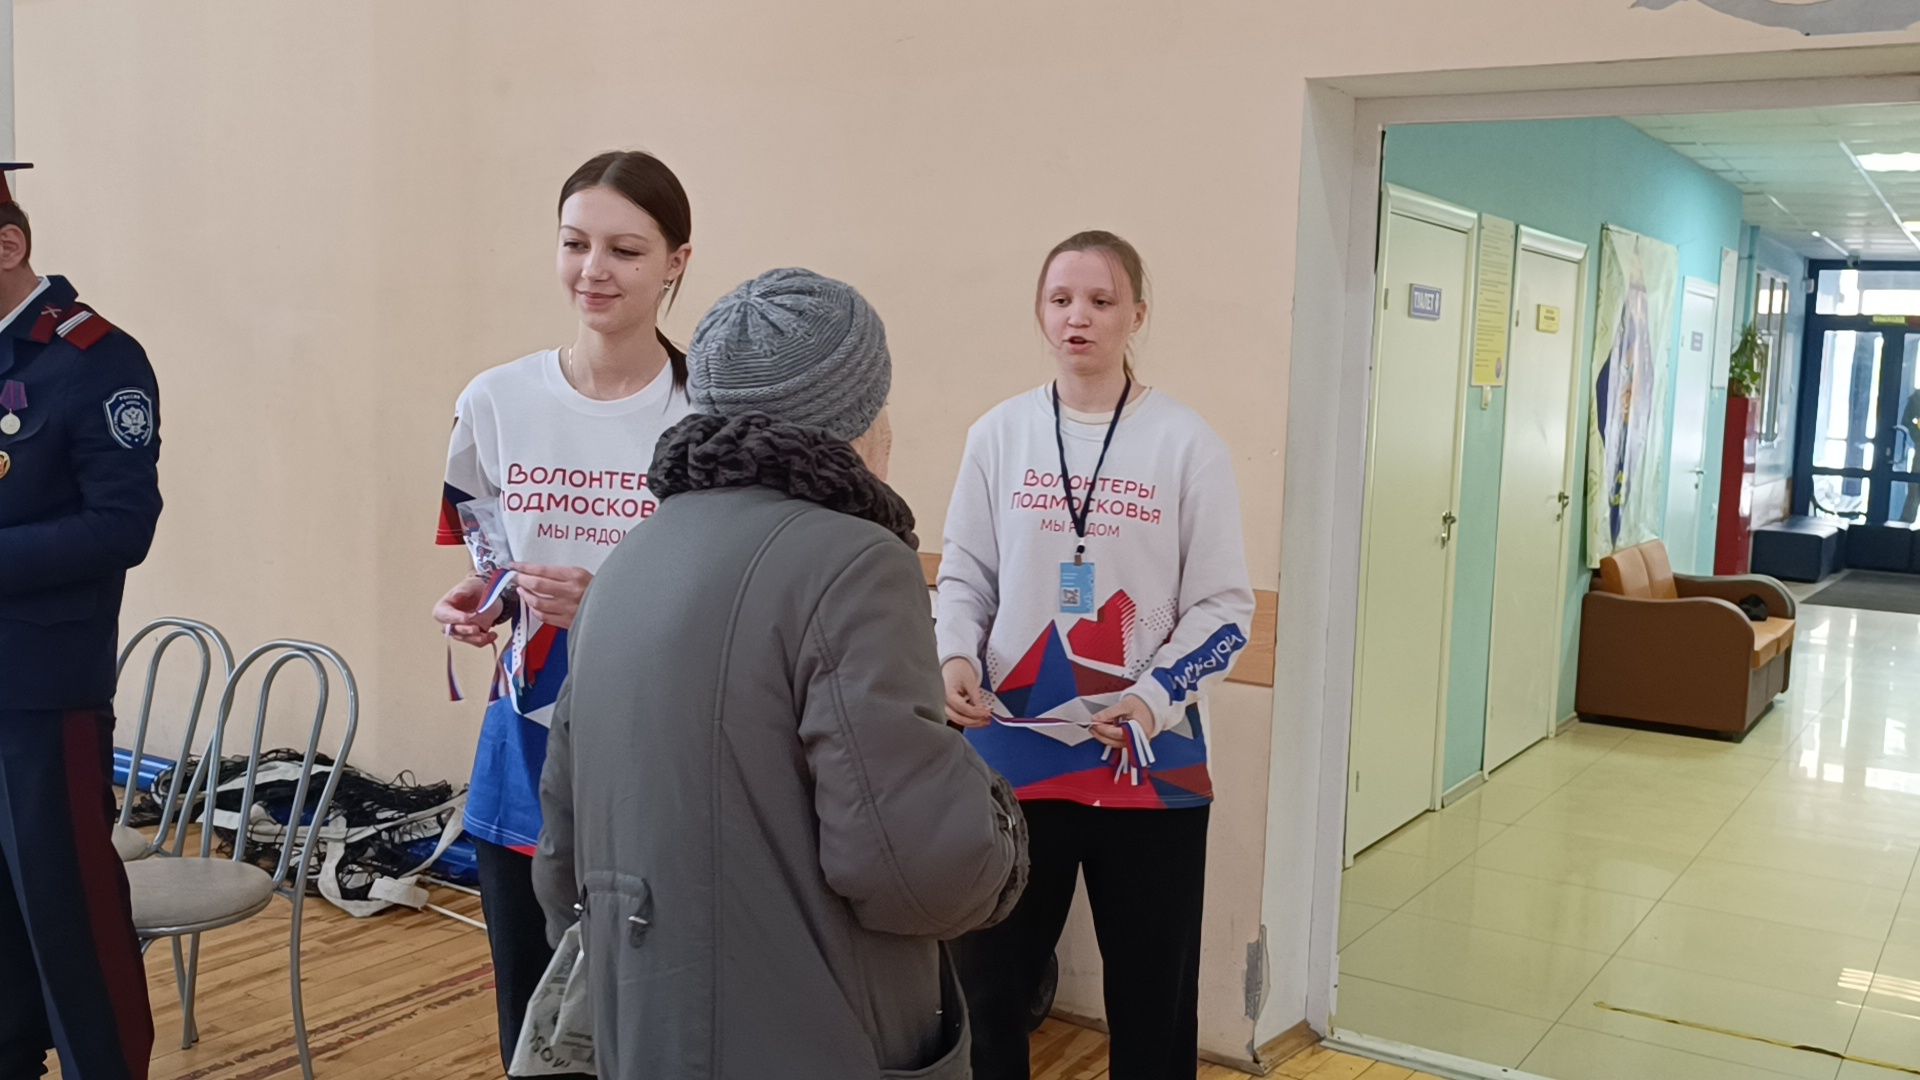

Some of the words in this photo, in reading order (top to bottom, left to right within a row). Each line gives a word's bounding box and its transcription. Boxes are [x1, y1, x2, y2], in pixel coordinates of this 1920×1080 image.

[507, 463, 649, 491] ВОЛОНТЕР
[502, 490, 657, 518] ОДМОСКОВ
[537, 523, 569, 540] МЫ
[574, 526, 627, 546] РЯДО
[1040, 519, 1065, 532] МЫ
[1069, 520, 1120, 538] РДОМ
